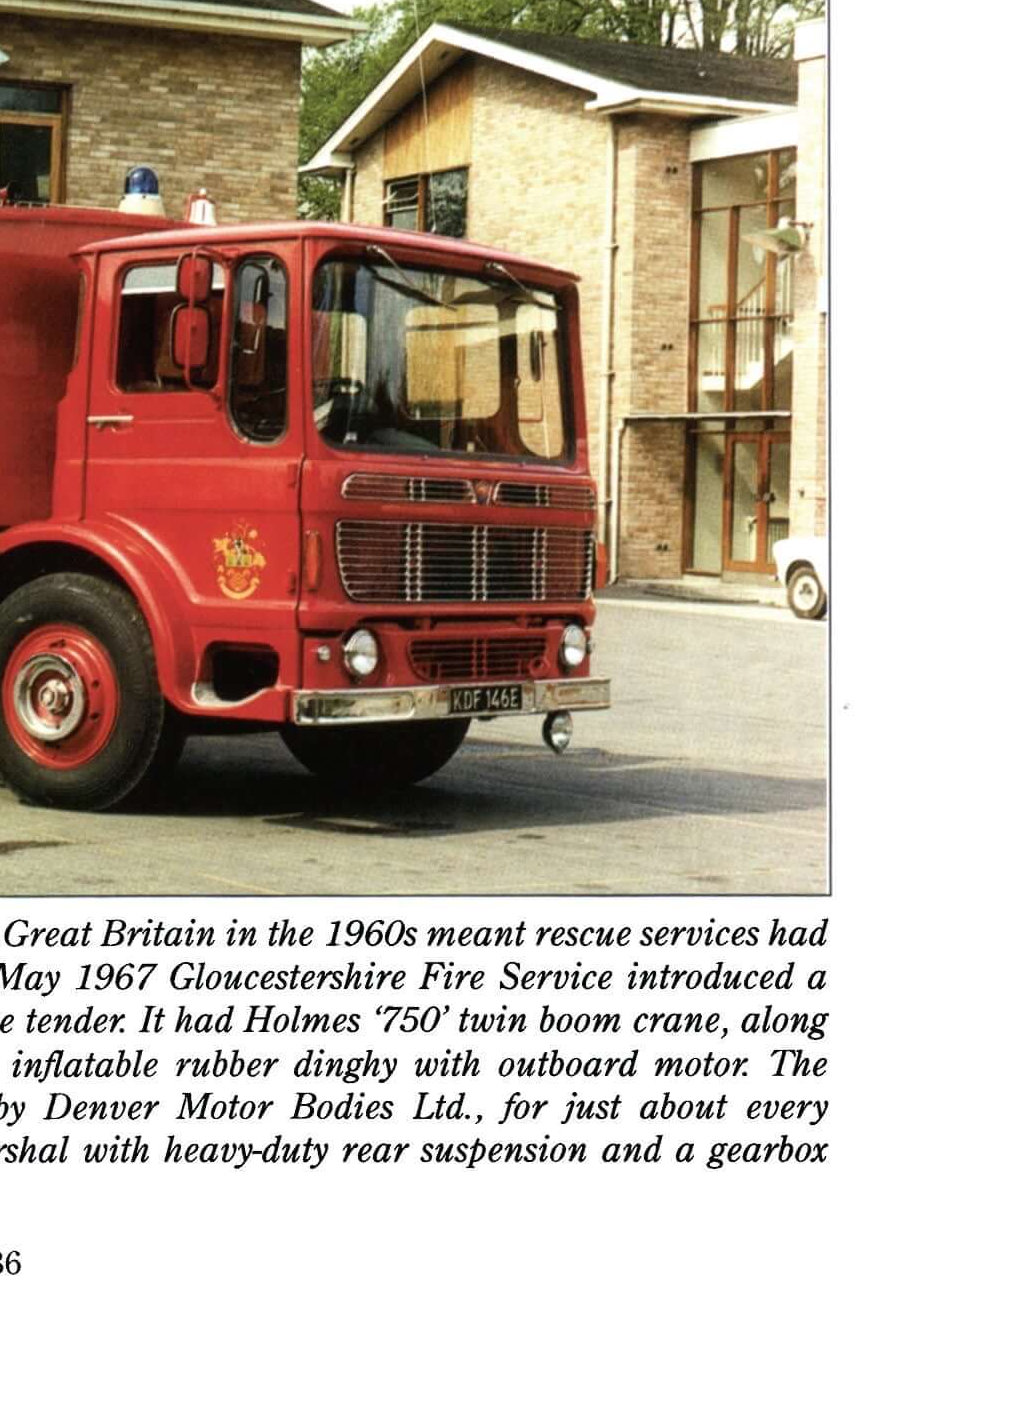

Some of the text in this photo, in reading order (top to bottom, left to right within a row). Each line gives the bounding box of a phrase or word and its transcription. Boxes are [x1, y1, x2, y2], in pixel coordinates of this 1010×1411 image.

[453, 687, 519, 710] KDF 146E
[4, 918, 93, 948] Great
[99, 918, 216, 947] Britain
[226, 918, 257, 947] in
[268, 918, 314, 947] the
[325, 919, 418, 947] 1960s
[427, 920, 527, 947] meant
[535, 926, 632, 947] rescue
[639, 917, 760, 947] services
[768, 917, 829, 947] had
[75, 962, 159, 991] 1967
[169, 961, 407, 991] Gloucestershire
[418, 961, 485, 990] Fire
[499, 961, 613, 991] Service
[627, 961, 796, 990] introduced
[807, 970, 827, 990] a
[12, 1049, 159, 1084] inflatable
[175, 1049, 280, 1078] rubber
[293, 1048, 398, 1084] dinghy
[414, 1048, 481, 1078] with
[498, 1049, 639, 1078] outboard
[654, 1051, 749, 1078] motor.
[770, 1049, 828, 1077] The
[42, 1092, 160, 1121] Denver
[175, 1092, 274, 1120] Motor
[290, 1091, 395, 1120] Bodies
[412, 1091, 483, 1125] Ltd.,
[497, 1091, 549, 1125] for
[560, 1091, 623, 1125] just
[639, 1091, 729, 1120] about
[746, 1099, 829, 1126] every
[83, 1134, 150, 1164] with
[163, 1134, 329, 1170] heavy-duty
[342, 1142, 411, 1164] rear
[419, 1134, 587, 1169] suspension
[601, 1134, 664, 1163] and
[675, 1142, 695, 1163] a
[705, 1134, 829, 1170] gearbox
